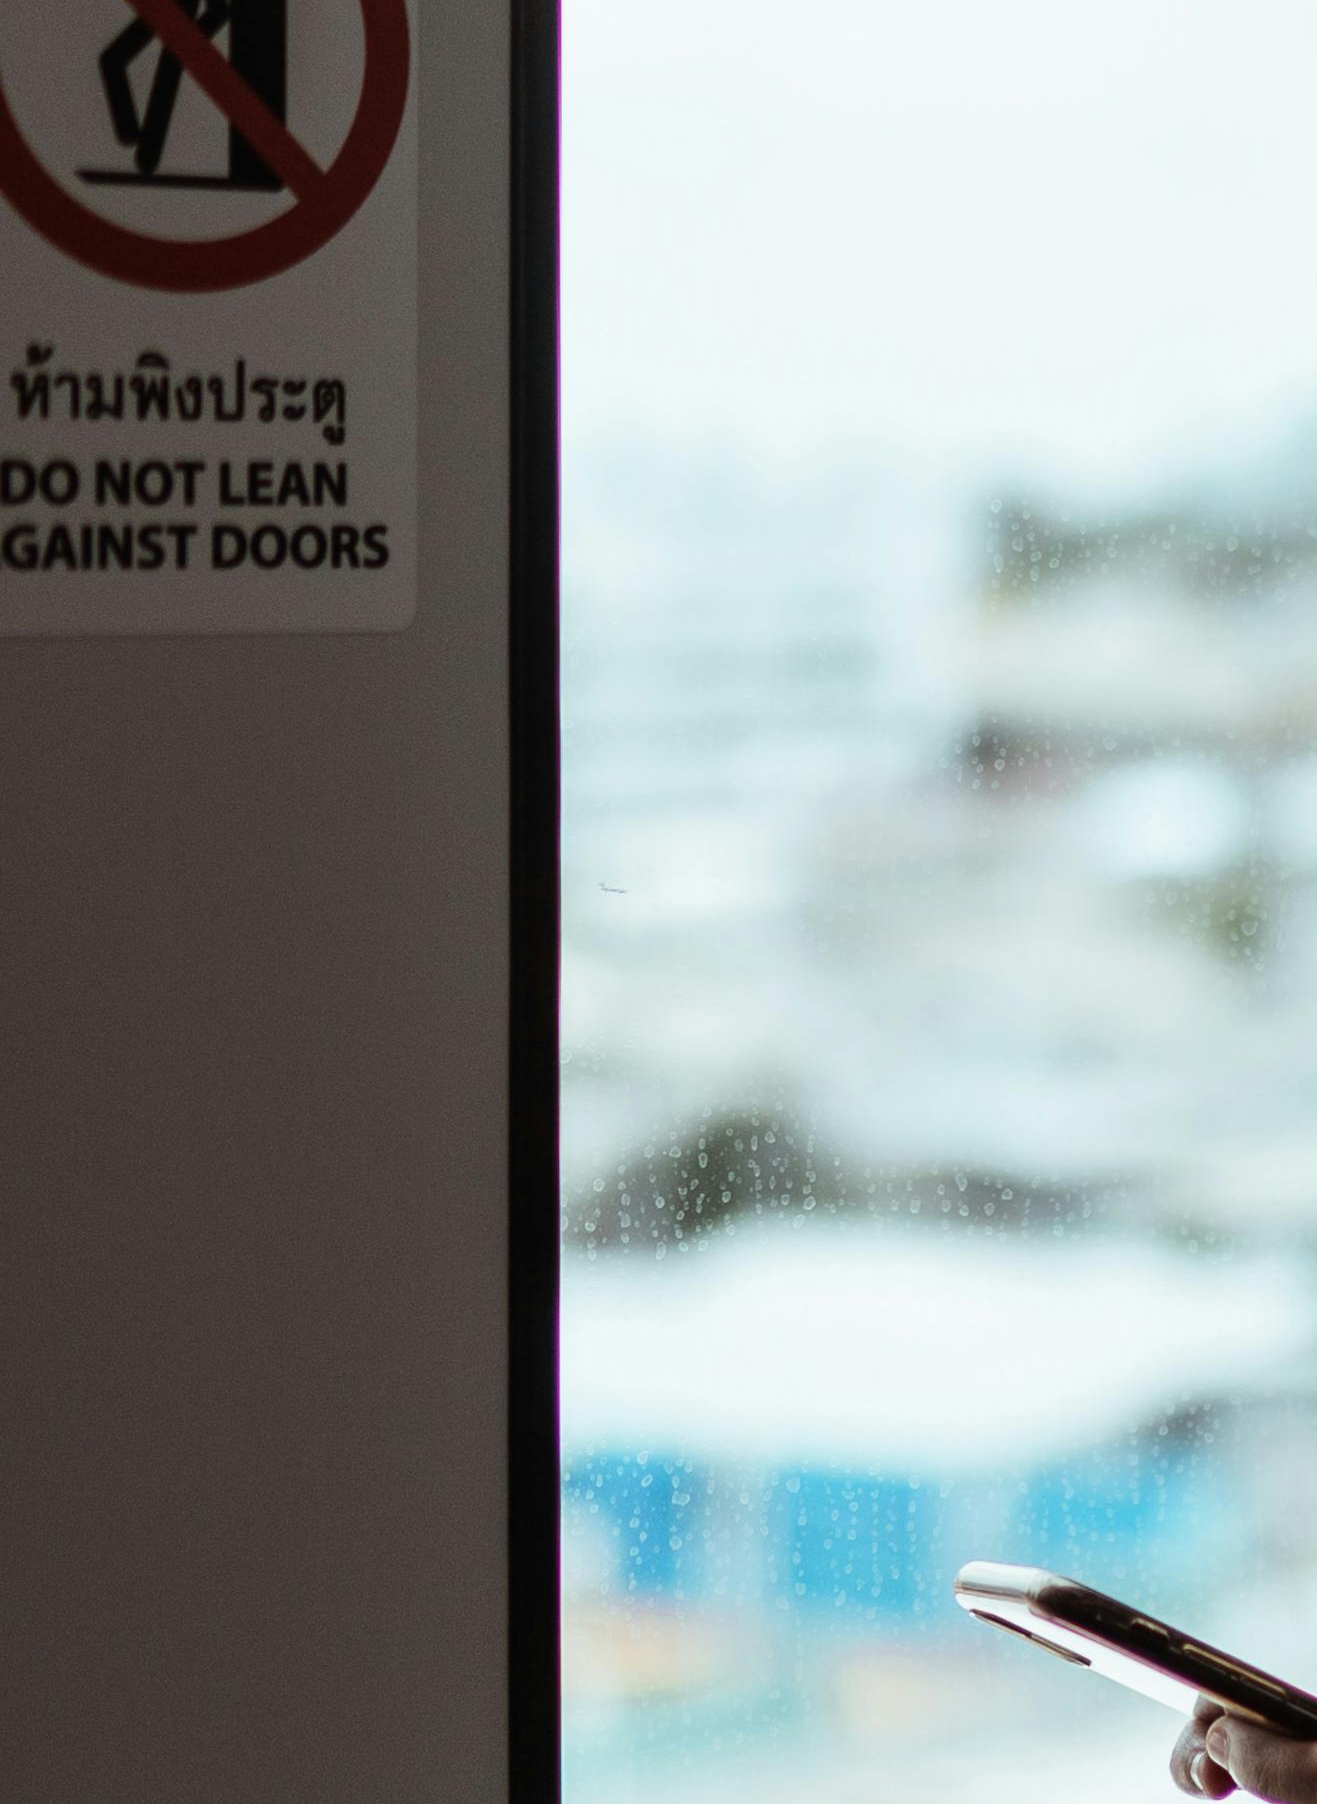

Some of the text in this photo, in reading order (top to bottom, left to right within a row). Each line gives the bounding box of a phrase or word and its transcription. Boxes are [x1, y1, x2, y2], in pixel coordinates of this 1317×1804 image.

[10, 341, 346, 446] ห้ามพิงประตู
[0, 458, 347, 507] DO NOT LEAN
[0, 523, 389, 571] GAINST DOORS
